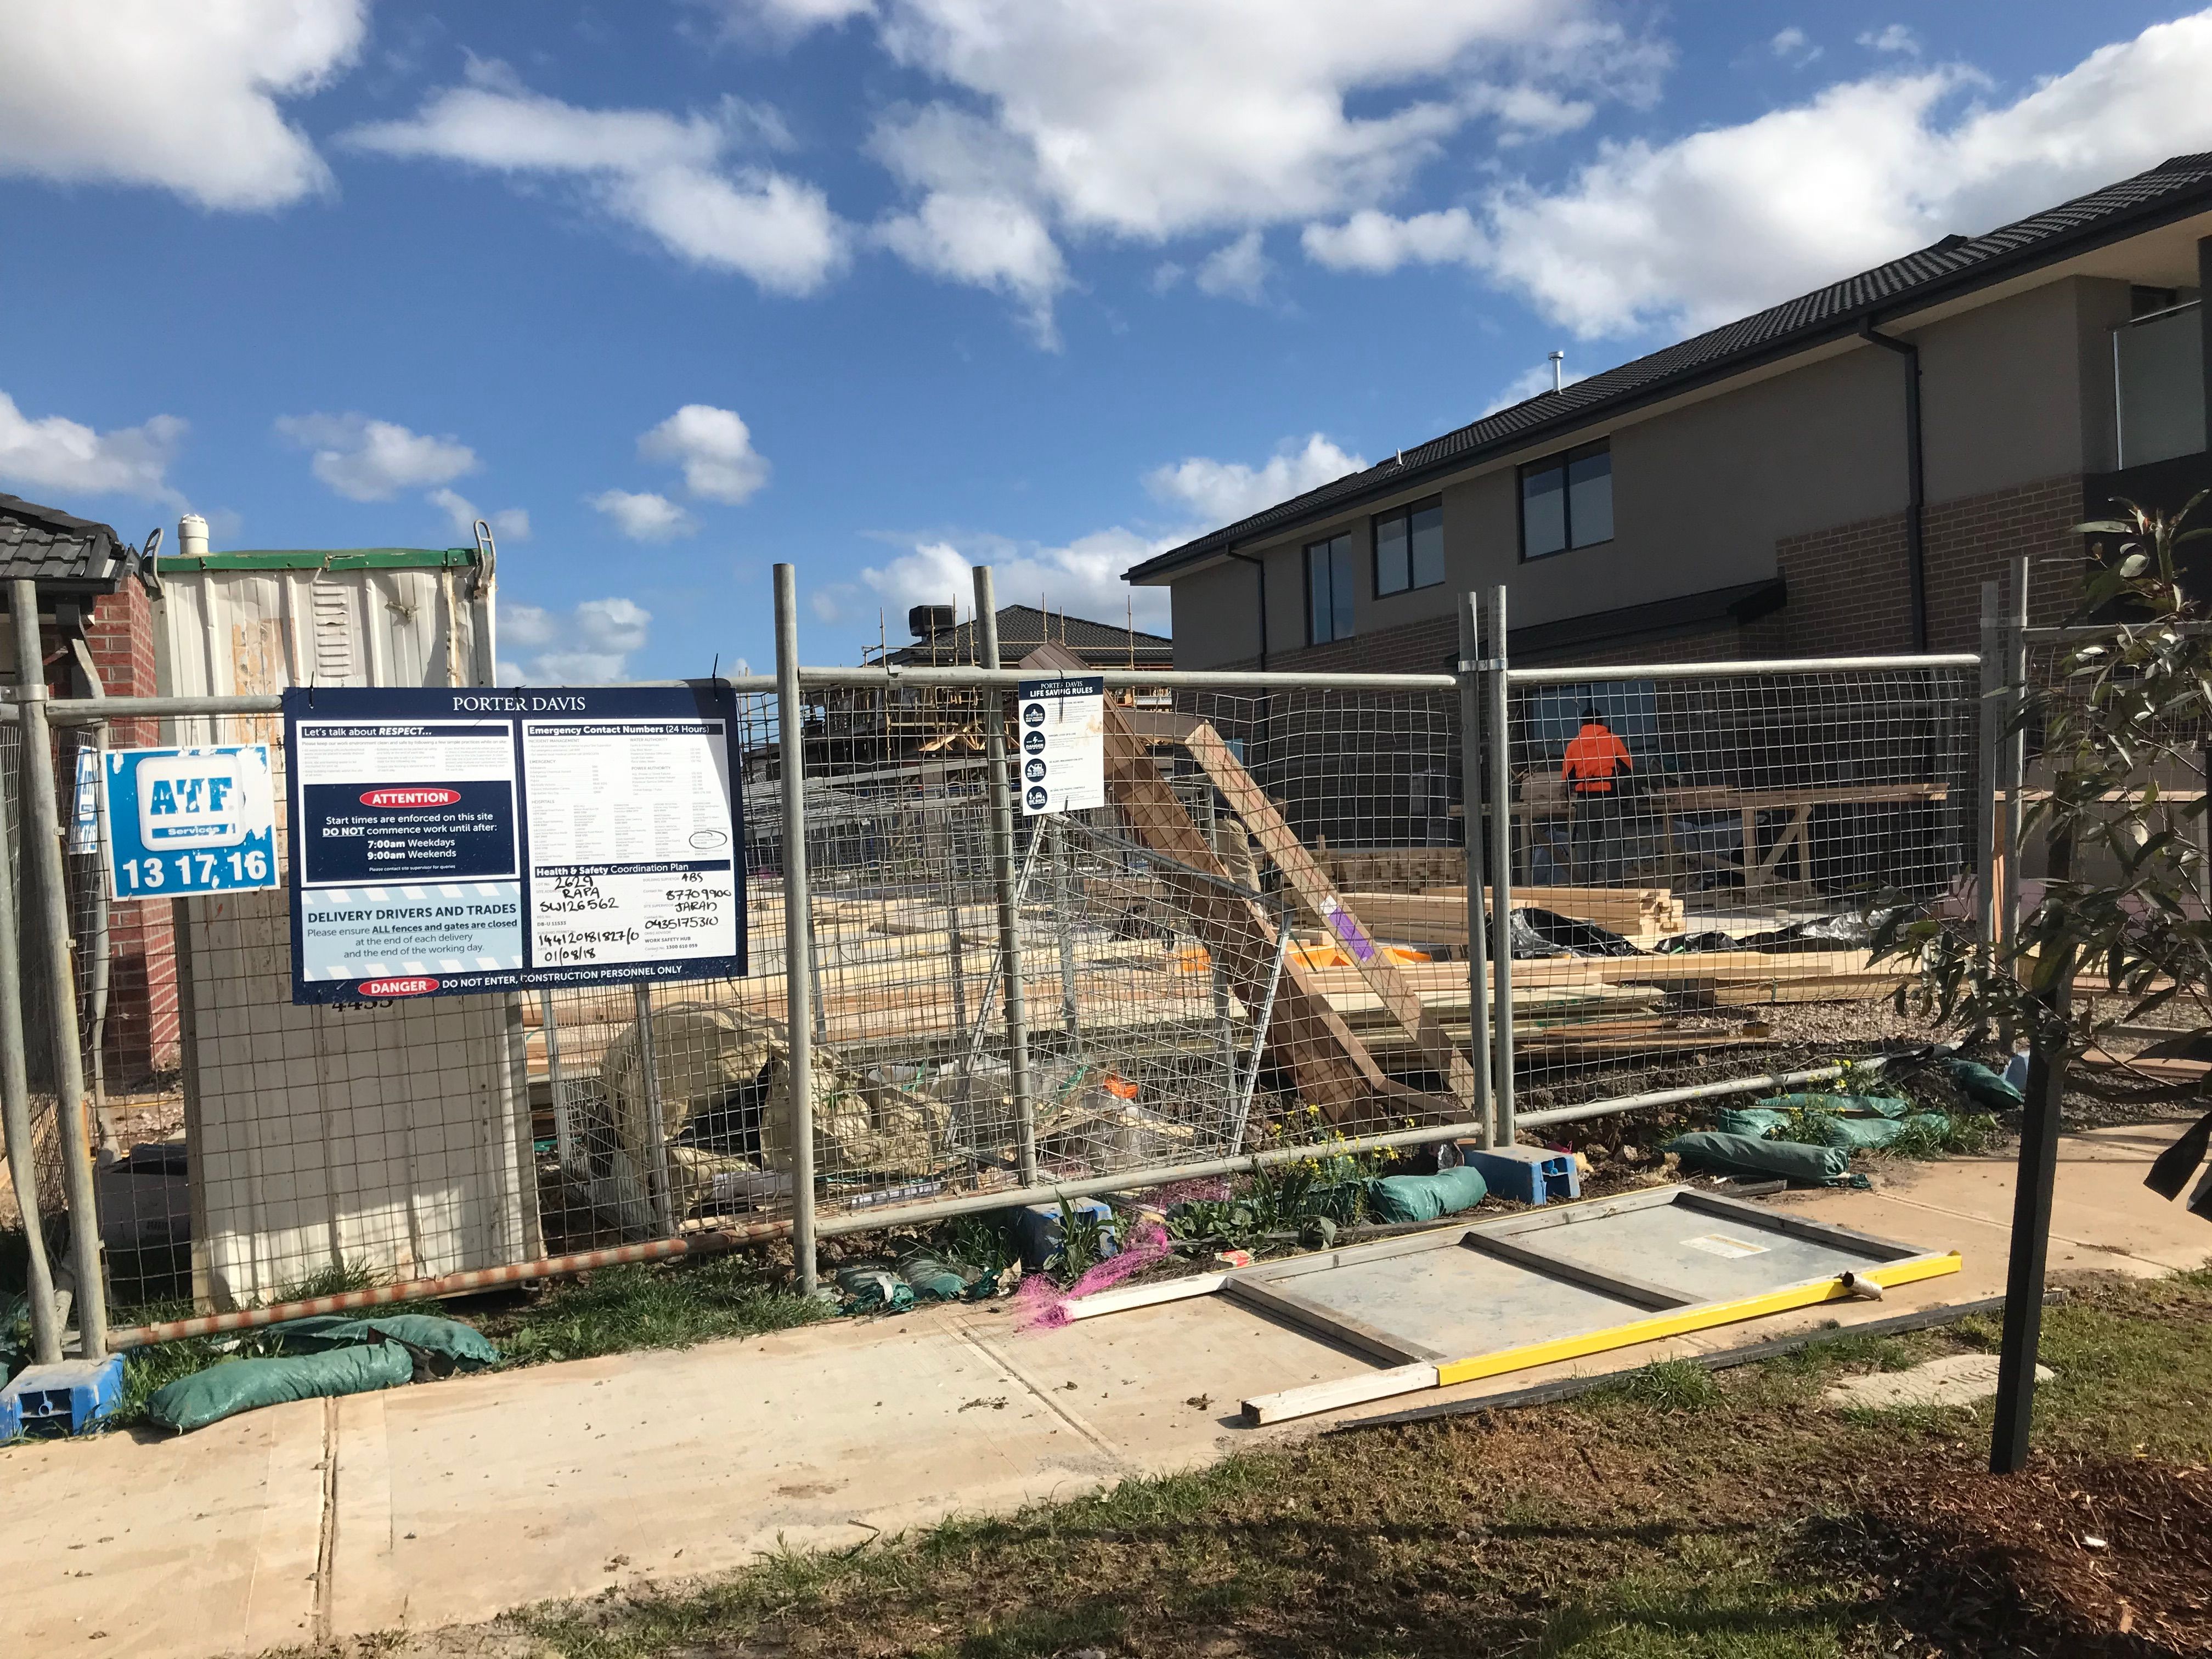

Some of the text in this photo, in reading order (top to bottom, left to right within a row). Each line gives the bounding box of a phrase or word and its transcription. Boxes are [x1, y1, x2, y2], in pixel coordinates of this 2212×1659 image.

[453, 696, 586, 712] PORTER DAVIS
[329, 727, 347, 736] talk
[348, 727, 377, 736] about
[379, 727, 432, 736] RESPECT...
[529, 727, 582, 735] Emergency
[666, 725, 679, 733] (24
[681, 725, 709, 733] Hours)
[150, 777, 233, 815] ATF
[372, 793, 449, 804] ATTENTION
[326, 816, 349, 825] Start
[351, 815, 377, 824] times
[398, 814, 440, 823] enforced
[458, 813, 474, 821] this
[477, 812, 493, 821] site
[168, 826, 219, 836] Services
[323, 823, 497, 836] DO NOT commence work until after:
[368, 838, 455, 849] 7:00am Weekdays
[367, 849, 456, 860] 9:00am Weekends
[123, 850, 267, 889] 13 17 16
[537, 867, 568, 876] Health
[579, 866, 608, 875] Safety
[611, 864, 668, 873] Coordination
[555, 876, 594, 890] 2629
[681, 872, 703, 883] ABS
[562, 887, 600, 899] RAPA
[308, 904, 517, 923] DELIVERY DRIVERS AND TRADES
[307, 928, 337, 937] Please
[392, 924, 422, 933] fences
[425, 923, 442, 932] and
[444, 923, 469, 932] gates
[488, 919, 517, 928] closed
[366, 937, 381, 945] the
[384, 936, 401, 945] end
[403, 935, 413, 944] of
[415, 934, 437, 943] each
[438, 933, 473, 943] delivery
[343, 943, 485, 959] and the end of the working day.
[545, 946, 596, 966] 01/08/18
[442, 966, 682, 989] DO NOT ENTER, CONSTRUCTION PERSONNEL ONLY
[371, 981, 427, 994] DANGER
